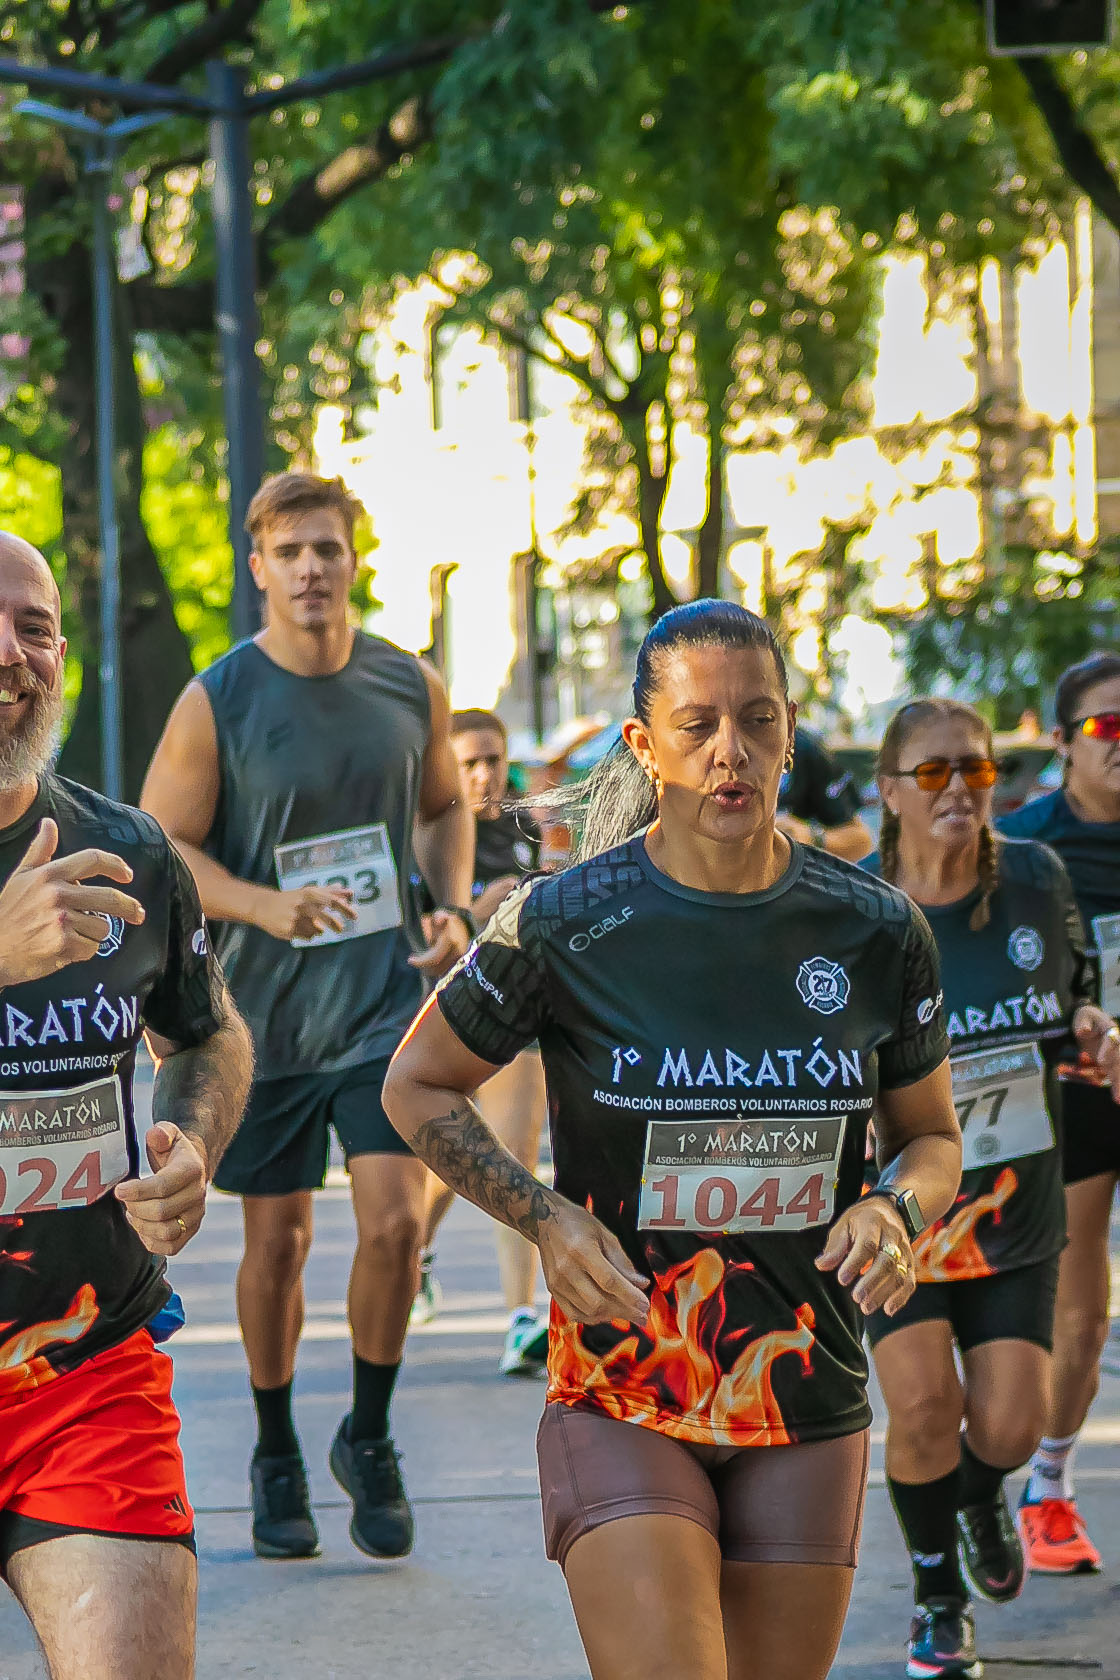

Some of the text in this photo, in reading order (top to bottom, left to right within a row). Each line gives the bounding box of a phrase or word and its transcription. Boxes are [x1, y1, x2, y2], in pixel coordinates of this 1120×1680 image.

[23, 1055, 109, 1074] VOLUNTARIOS
[657, 1036, 863, 1087] MARATÓN
[593, 1089, 873, 1111] ASOCIACIÓN BOMBEROS VOLUNTARIOS ROSARIO
[0, 1135, 42, 1147] BOMBEROS
[43, 1128, 91, 1143] VOLUNTARIOS
[704, 1125, 818, 1153] MARATÓN
[749, 1156, 800, 1167] VOLUNTARIOS
[649, 1173, 826, 1227] 1044
